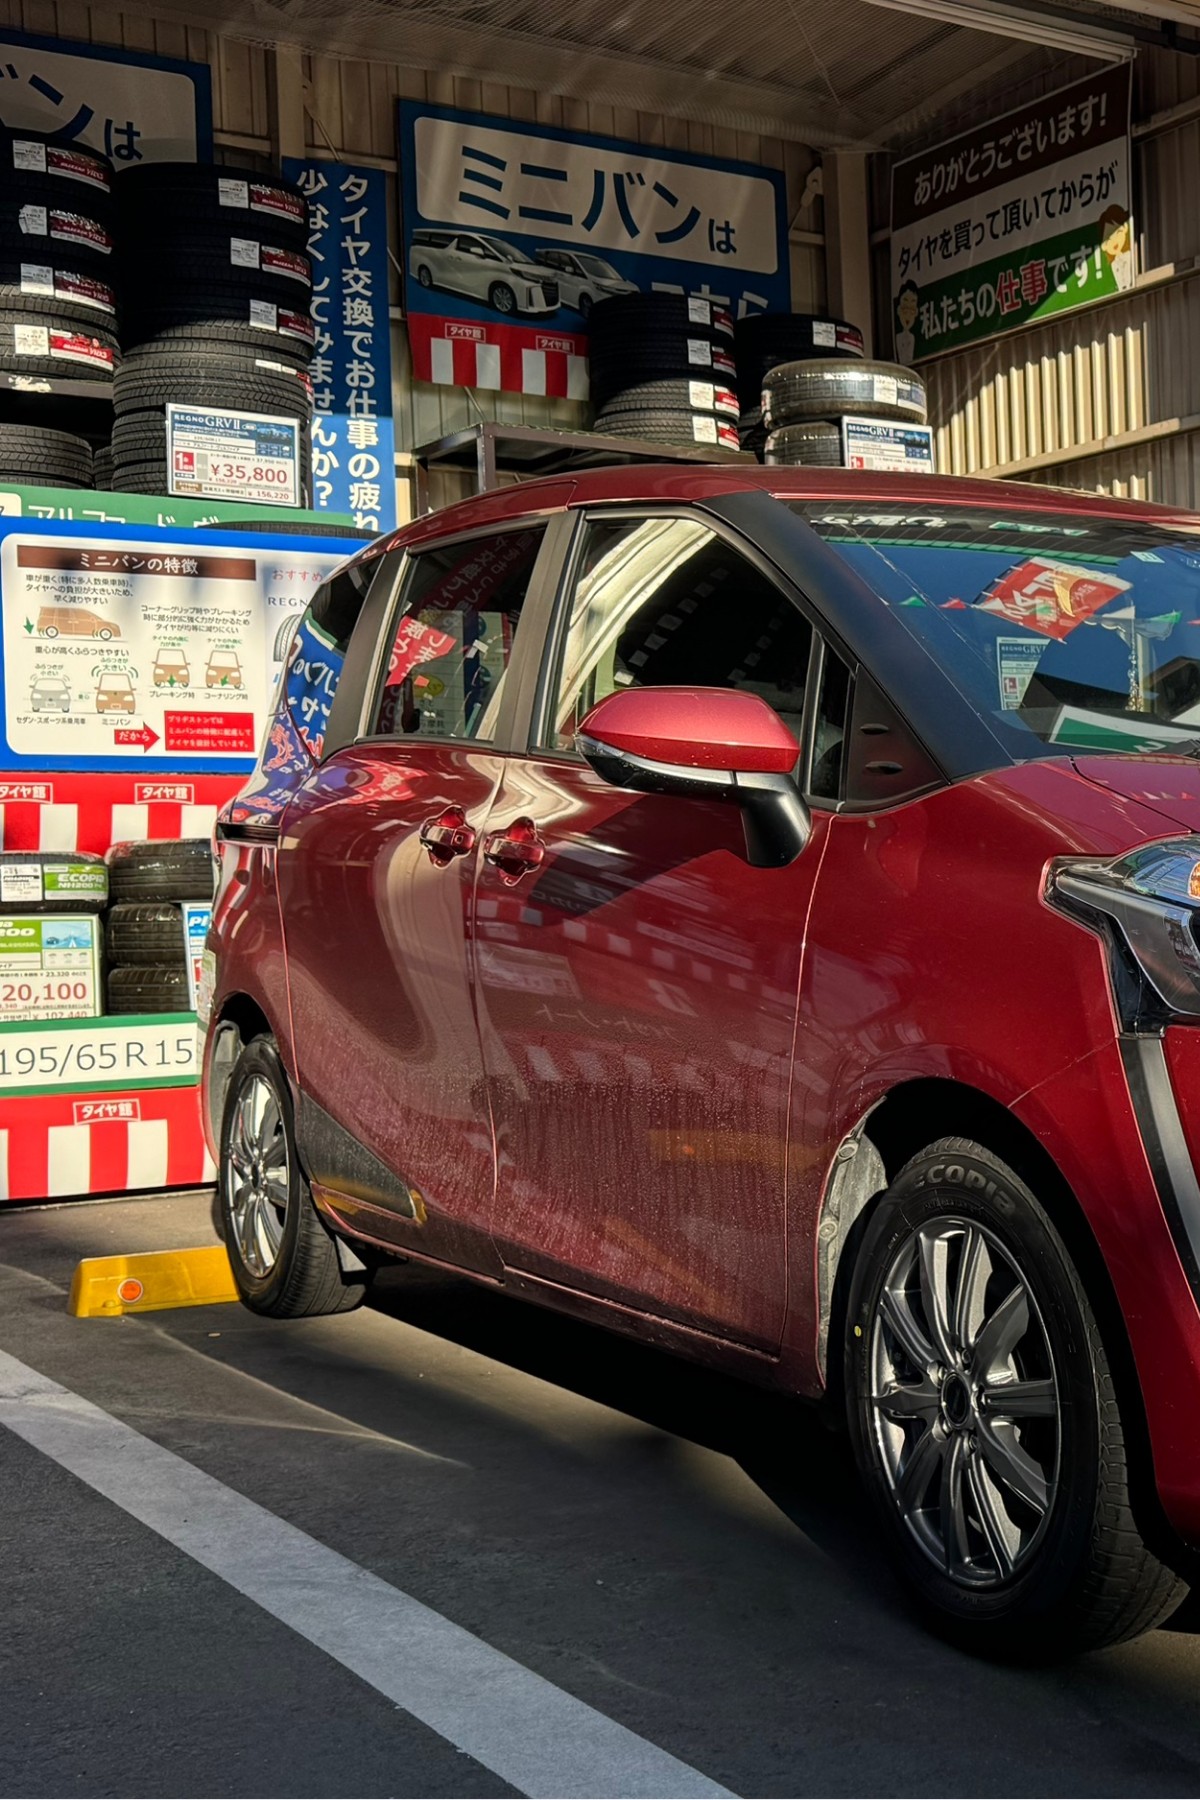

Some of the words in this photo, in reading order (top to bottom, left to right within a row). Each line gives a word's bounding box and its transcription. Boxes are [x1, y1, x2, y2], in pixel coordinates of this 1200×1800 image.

[914, 93, 1107, 206] ありがとうございます！
[458, 145, 738, 255] ミニバンは
[898, 160, 1118, 277] タイヤを買って頂いてからが
[919, 244, 1103, 340] 私たちの仕事です！
[80, 552, 199, 575] ミニバンの特徴
[119, 730, 150, 741] だから
[142, 787, 188, 799] タイヤ館
[82, 1102, 133, 1119] タイヤ館
